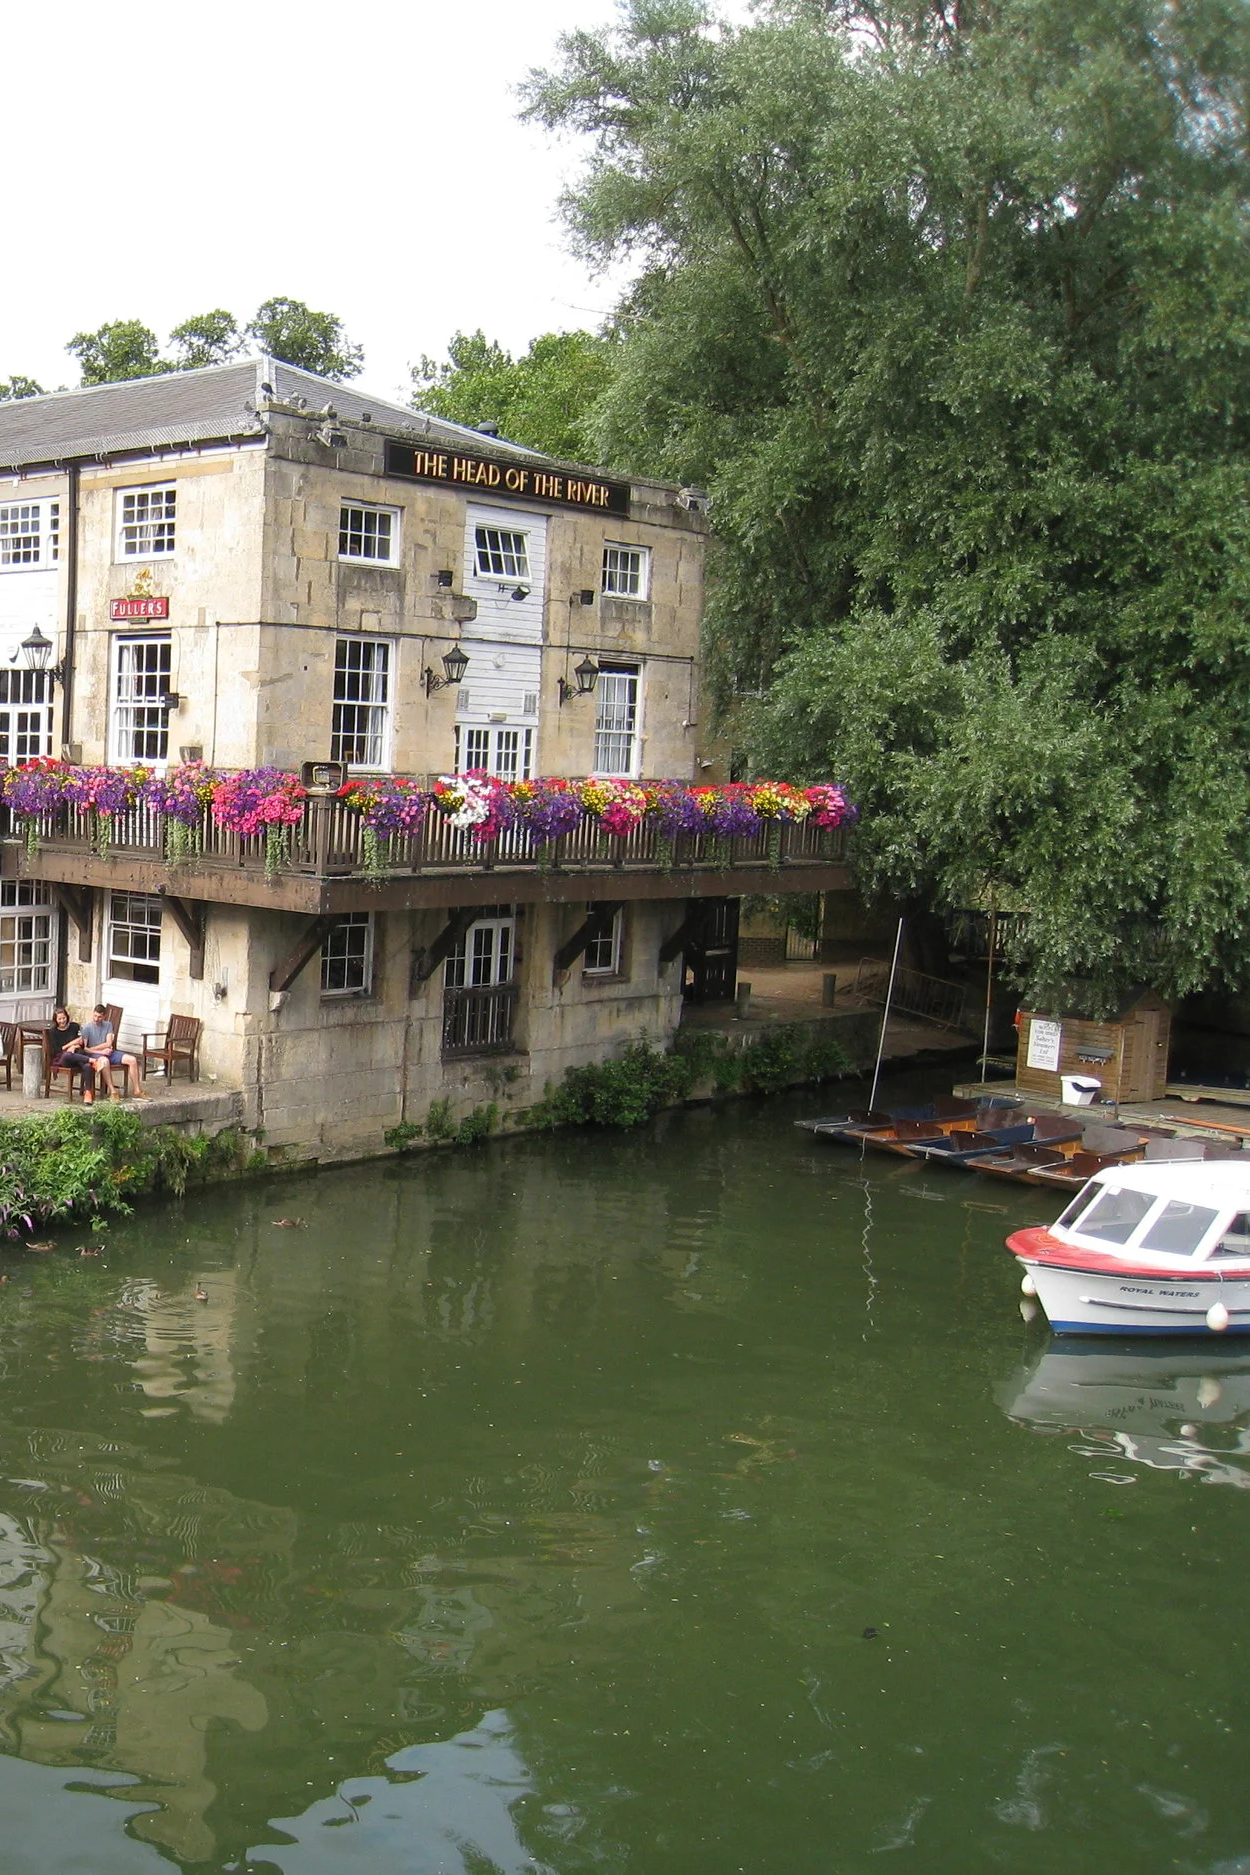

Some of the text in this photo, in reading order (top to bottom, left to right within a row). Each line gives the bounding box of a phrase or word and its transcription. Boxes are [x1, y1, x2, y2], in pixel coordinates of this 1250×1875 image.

[414, 450, 610, 507] THE HEAD OF THE RIVER
[112, 601, 162, 616] FULLER'S
[1119, 1286, 1200, 1298] ROYAL WATERS
